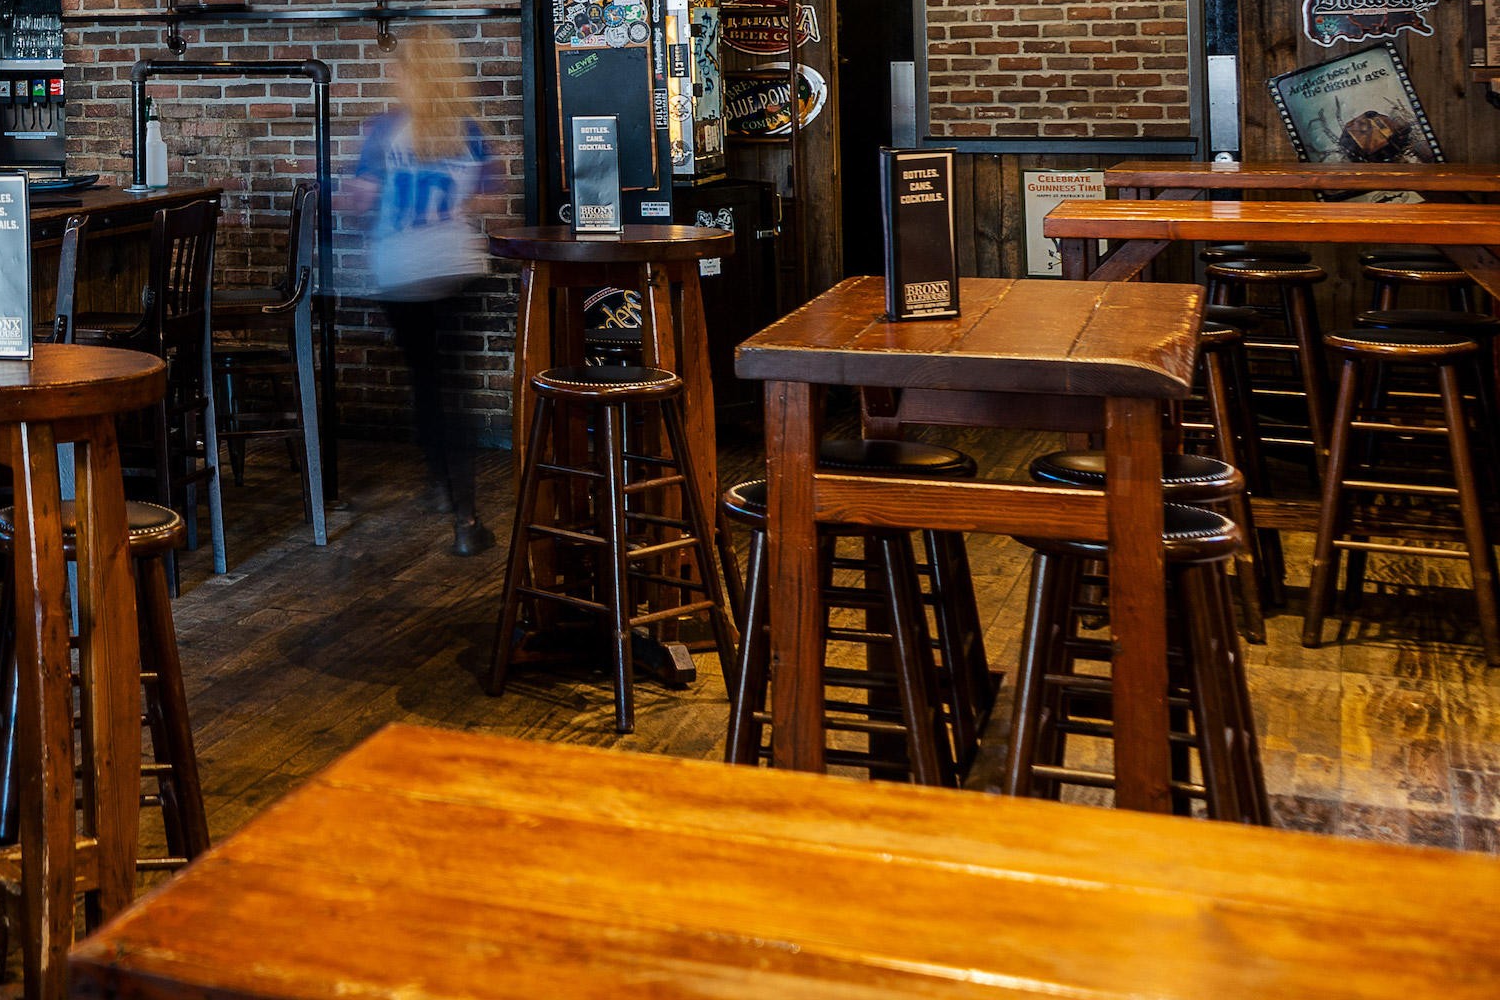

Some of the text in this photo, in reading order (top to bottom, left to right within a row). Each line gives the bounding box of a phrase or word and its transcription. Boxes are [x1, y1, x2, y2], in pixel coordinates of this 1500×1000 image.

[730, 31, 768, 40] BEER
[567, 53, 599, 75] ALEWIFE
[1289, 60, 1368, 96] Analog beer for
[1303, 68, 1390, 98] the digital age.
[724, 84, 791, 121] BLUE POIN
[655, 92, 663, 128] FULTON
[903, 169, 940, 179] BOTTLES.
[1038, 174, 1091, 183] CELEBRATE
[909, 182, 934, 191] CANS.
[1028, 183, 1102, 192] GUINNESS TIME
[900, 193, 945, 204] COCKTAILS.
[906, 282, 949, 296] BRONX
